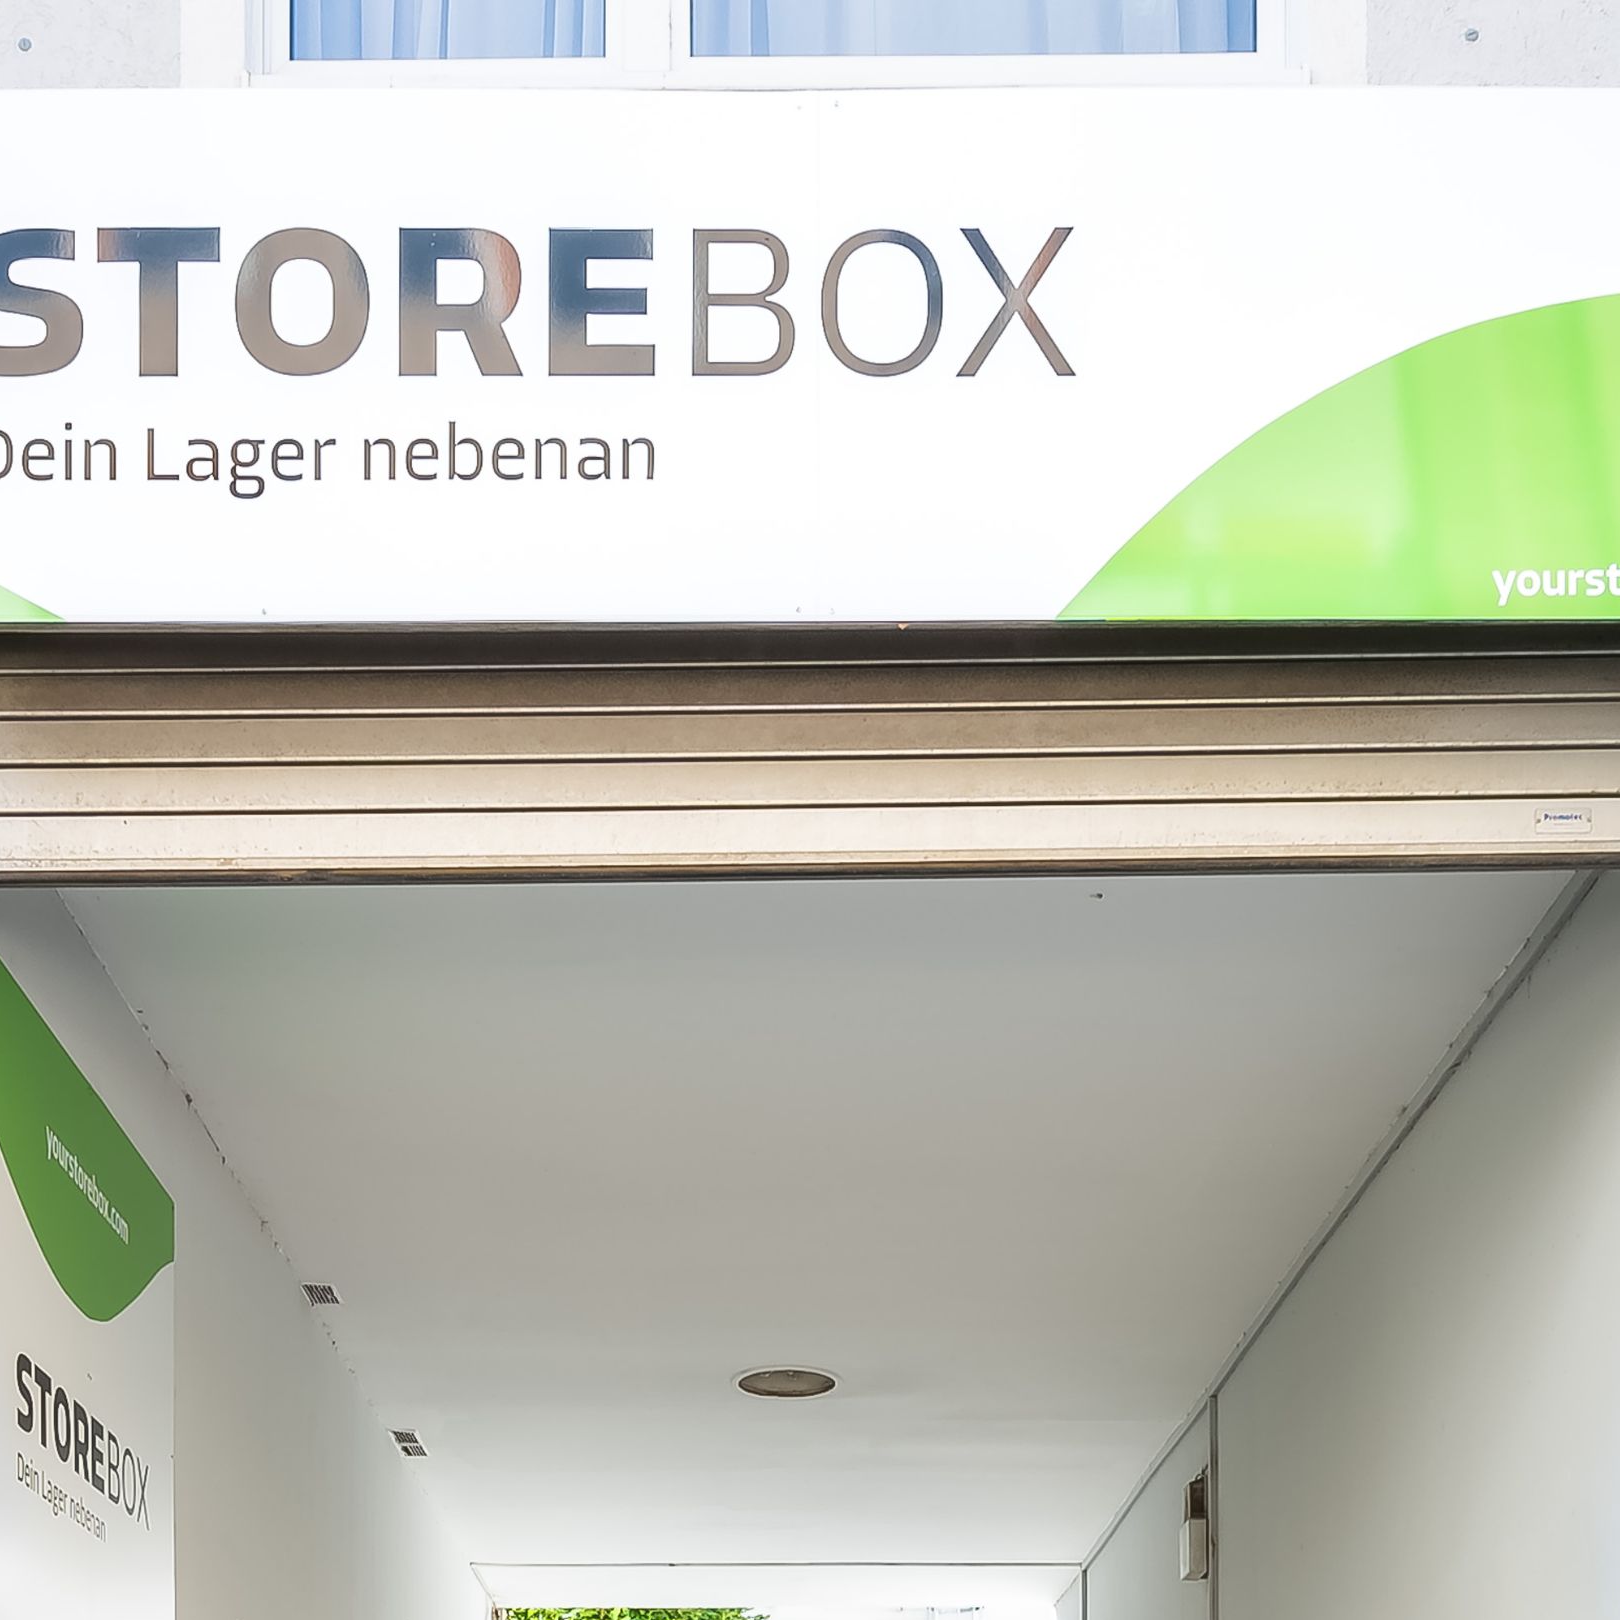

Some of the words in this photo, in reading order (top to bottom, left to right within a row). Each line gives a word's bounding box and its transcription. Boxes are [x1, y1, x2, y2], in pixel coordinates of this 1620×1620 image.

[146, 427, 337, 499] Lager
[363, 421, 656, 481] nebenan
[46, 1125, 129, 1245] yourstorebox.com
[16, 1353, 150, 1532] STOREBOX
[17, 1452, 40, 1494] Dein
[42, 1471, 68, 1517] Lager
[70, 1497, 106, 1543] nebenan
